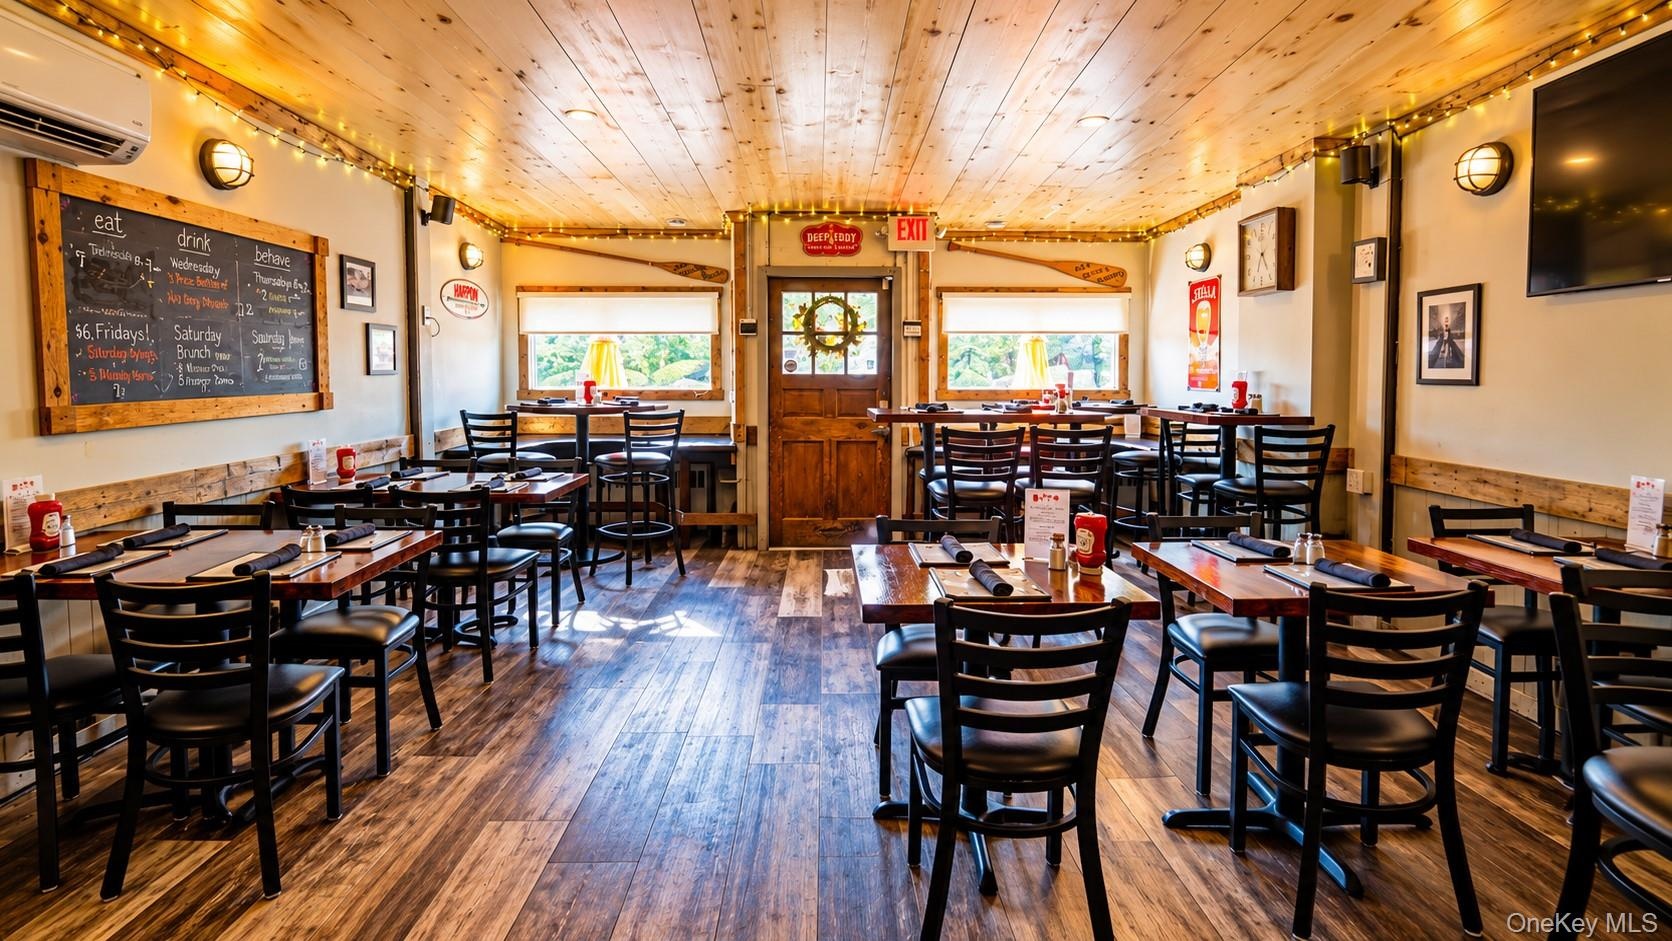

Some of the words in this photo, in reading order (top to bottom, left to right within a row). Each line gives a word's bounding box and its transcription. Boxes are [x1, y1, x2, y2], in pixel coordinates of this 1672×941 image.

[94, 211, 123, 233] eat
[897, 218, 929, 241] EXIT
[177, 227, 212, 252] drink
[807, 232, 830, 243] DEEP
[834, 232, 857, 243] EDDY
[254, 245, 291, 268] behave
[174, 324, 222, 348] Saturday
[176, 344, 211, 360] Brunch
